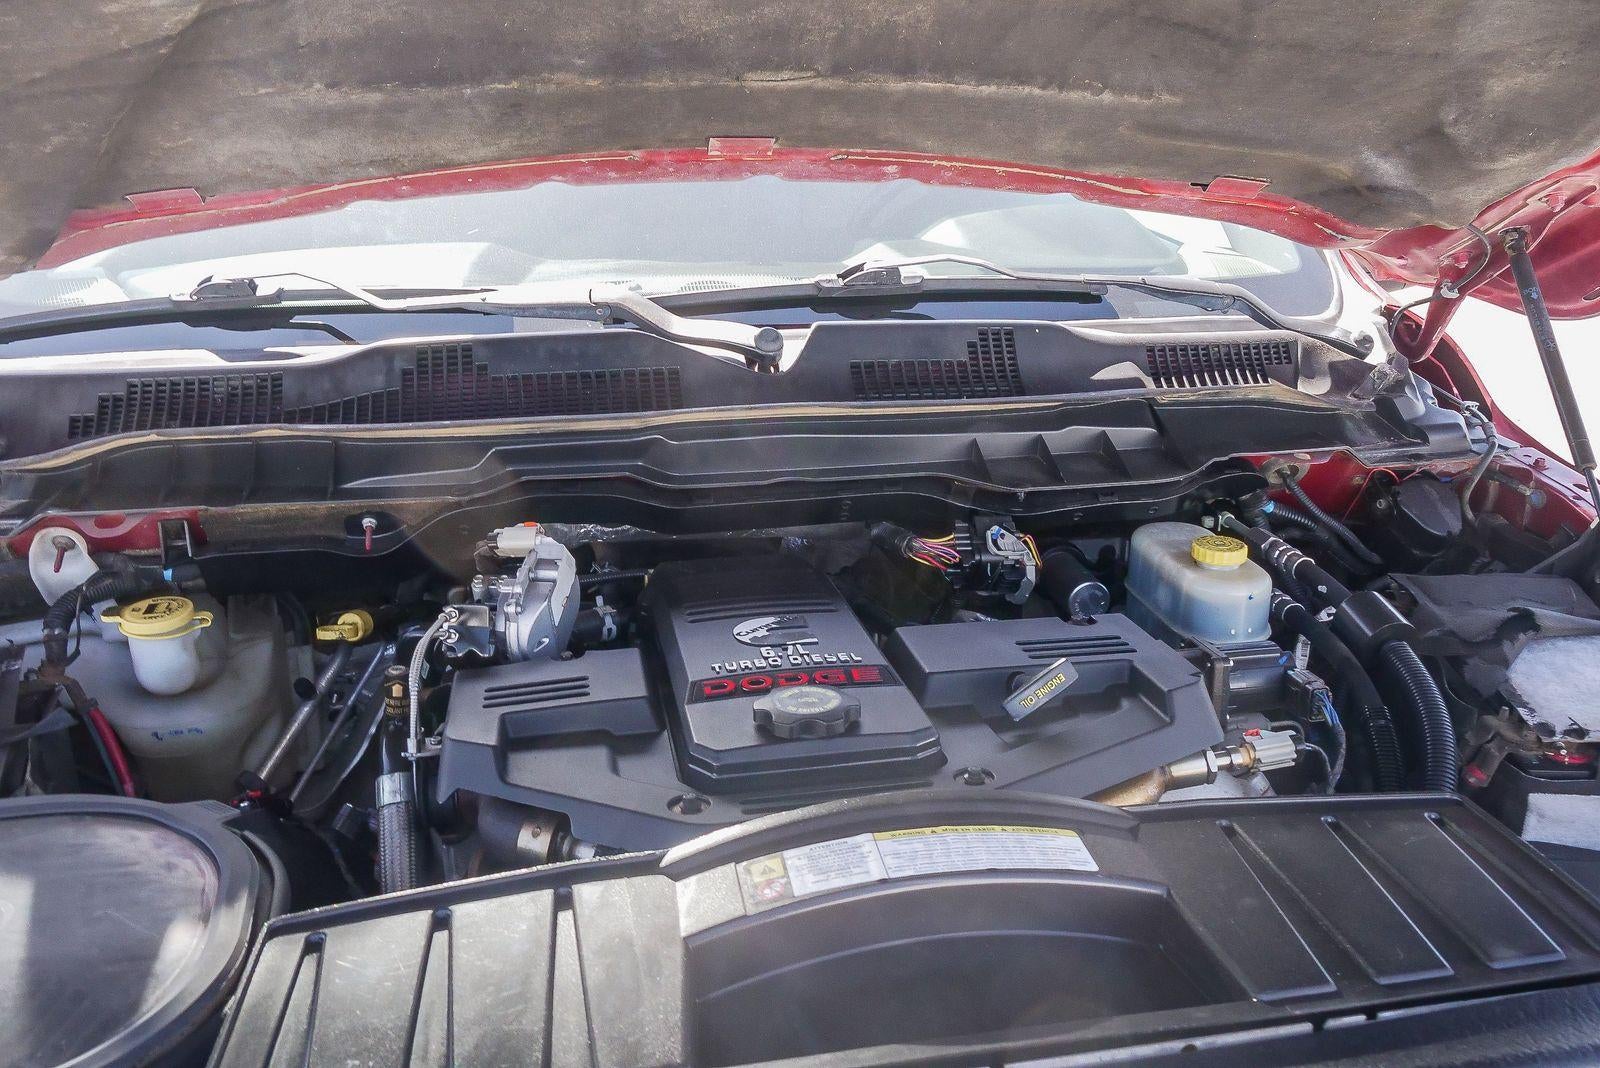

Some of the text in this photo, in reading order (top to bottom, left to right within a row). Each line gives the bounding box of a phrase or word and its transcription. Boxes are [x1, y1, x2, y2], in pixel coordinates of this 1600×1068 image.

[711, 652, 862, 674] TURBO DIESEL
[760, 644, 808, 658] 6.7L
[703, 667, 883, 695] DODGE
[1020, 673, 1066, 708] ENGINE OIL
